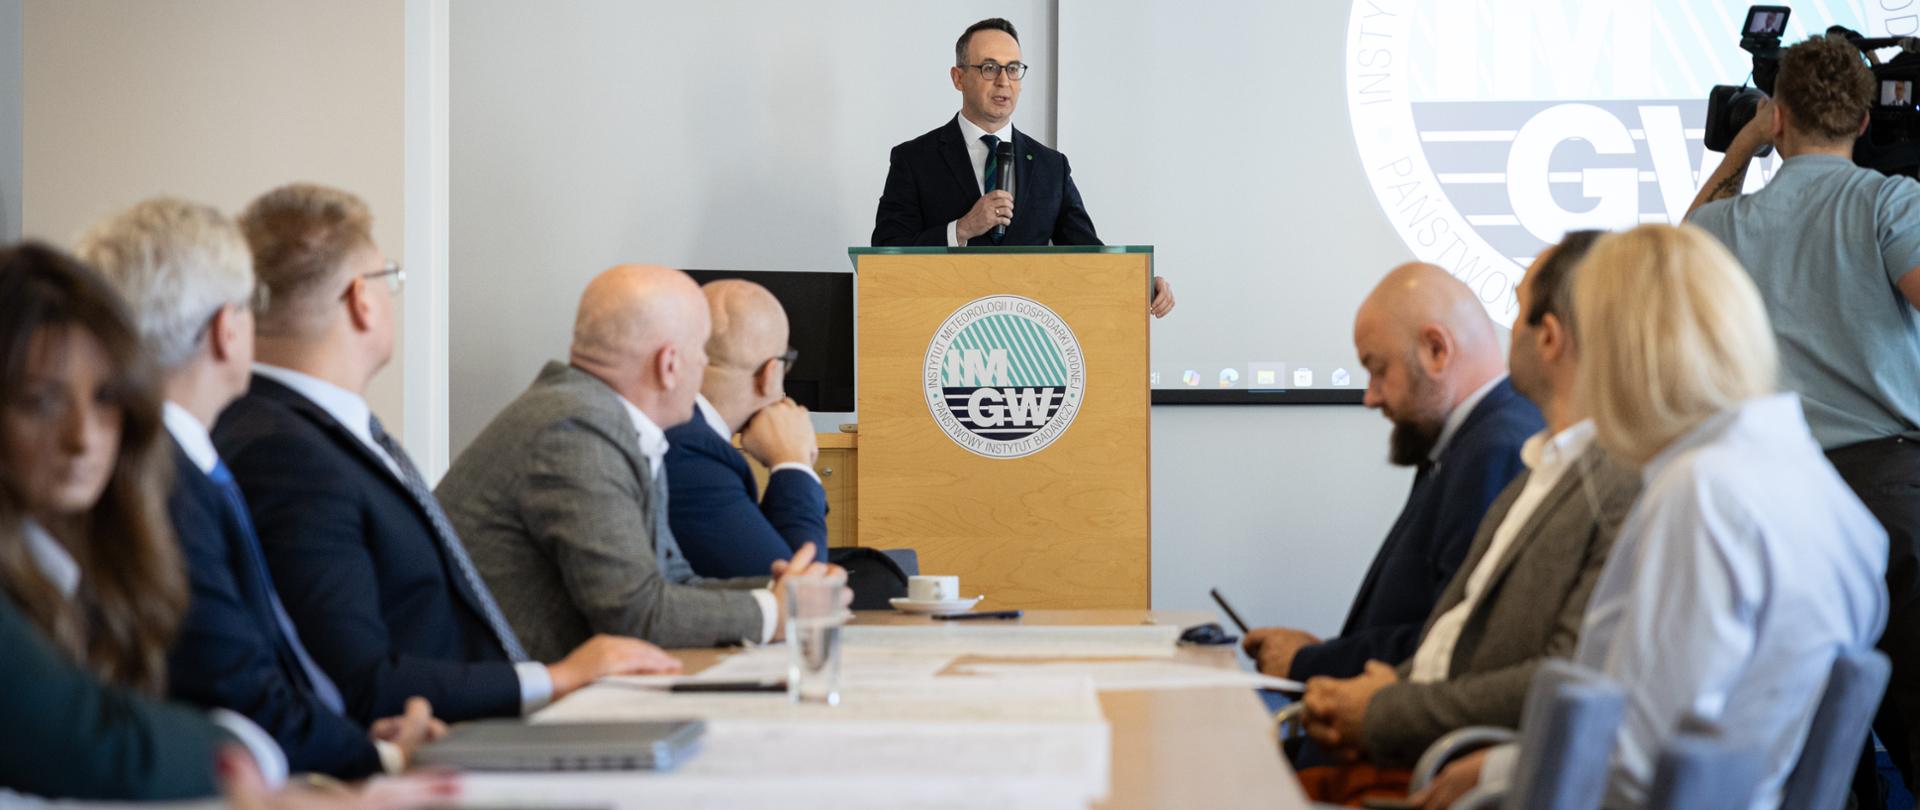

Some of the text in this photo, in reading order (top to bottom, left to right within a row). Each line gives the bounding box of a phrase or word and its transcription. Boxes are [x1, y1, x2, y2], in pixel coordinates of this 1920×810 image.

[927, 341, 945, 389] INSTYTUT
[941, 301, 1008, 341] METEOROLOGII
[1016, 302, 1070, 346] GOSPODARKI
[1065, 345, 1081, 390] WODNEJ
[947, 348, 1008, 387] IM
[967, 387, 1055, 428] GW
[985, 440, 1032, 455] INSTYTUT
[1033, 402, 1075, 446] BADAWCZY
